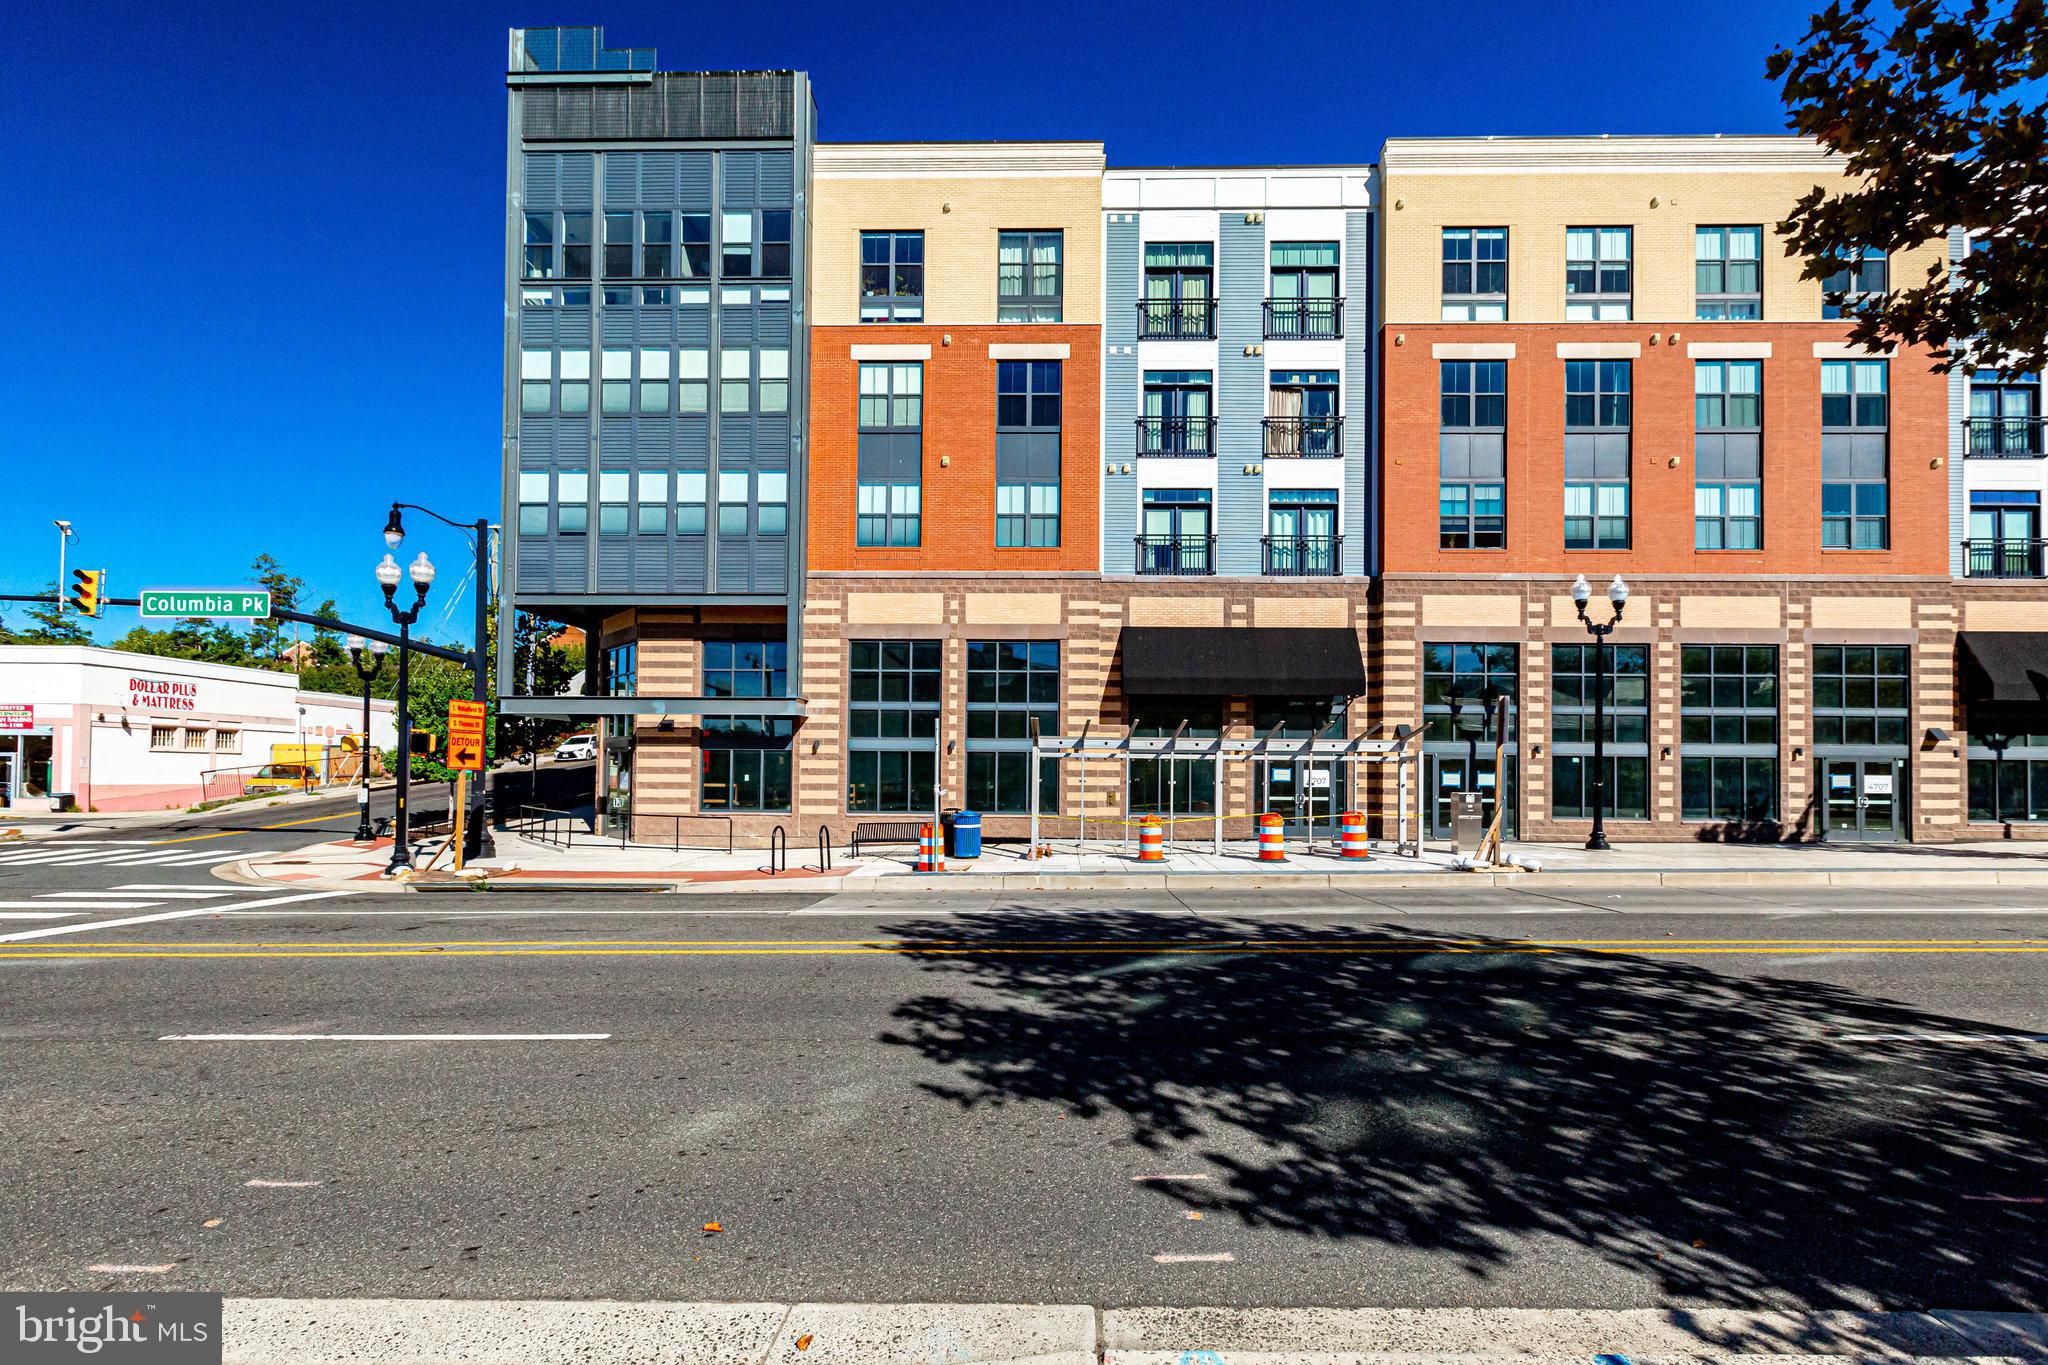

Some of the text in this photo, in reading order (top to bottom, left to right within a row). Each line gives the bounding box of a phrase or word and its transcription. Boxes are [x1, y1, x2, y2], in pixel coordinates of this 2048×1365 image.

[147, 597, 264, 612] Columbia Pk
[129, 678, 197, 697] DOLLAR PLUS
[132, 694, 194, 710] & MATTRESS
[452, 737, 480, 747] DETOUR
